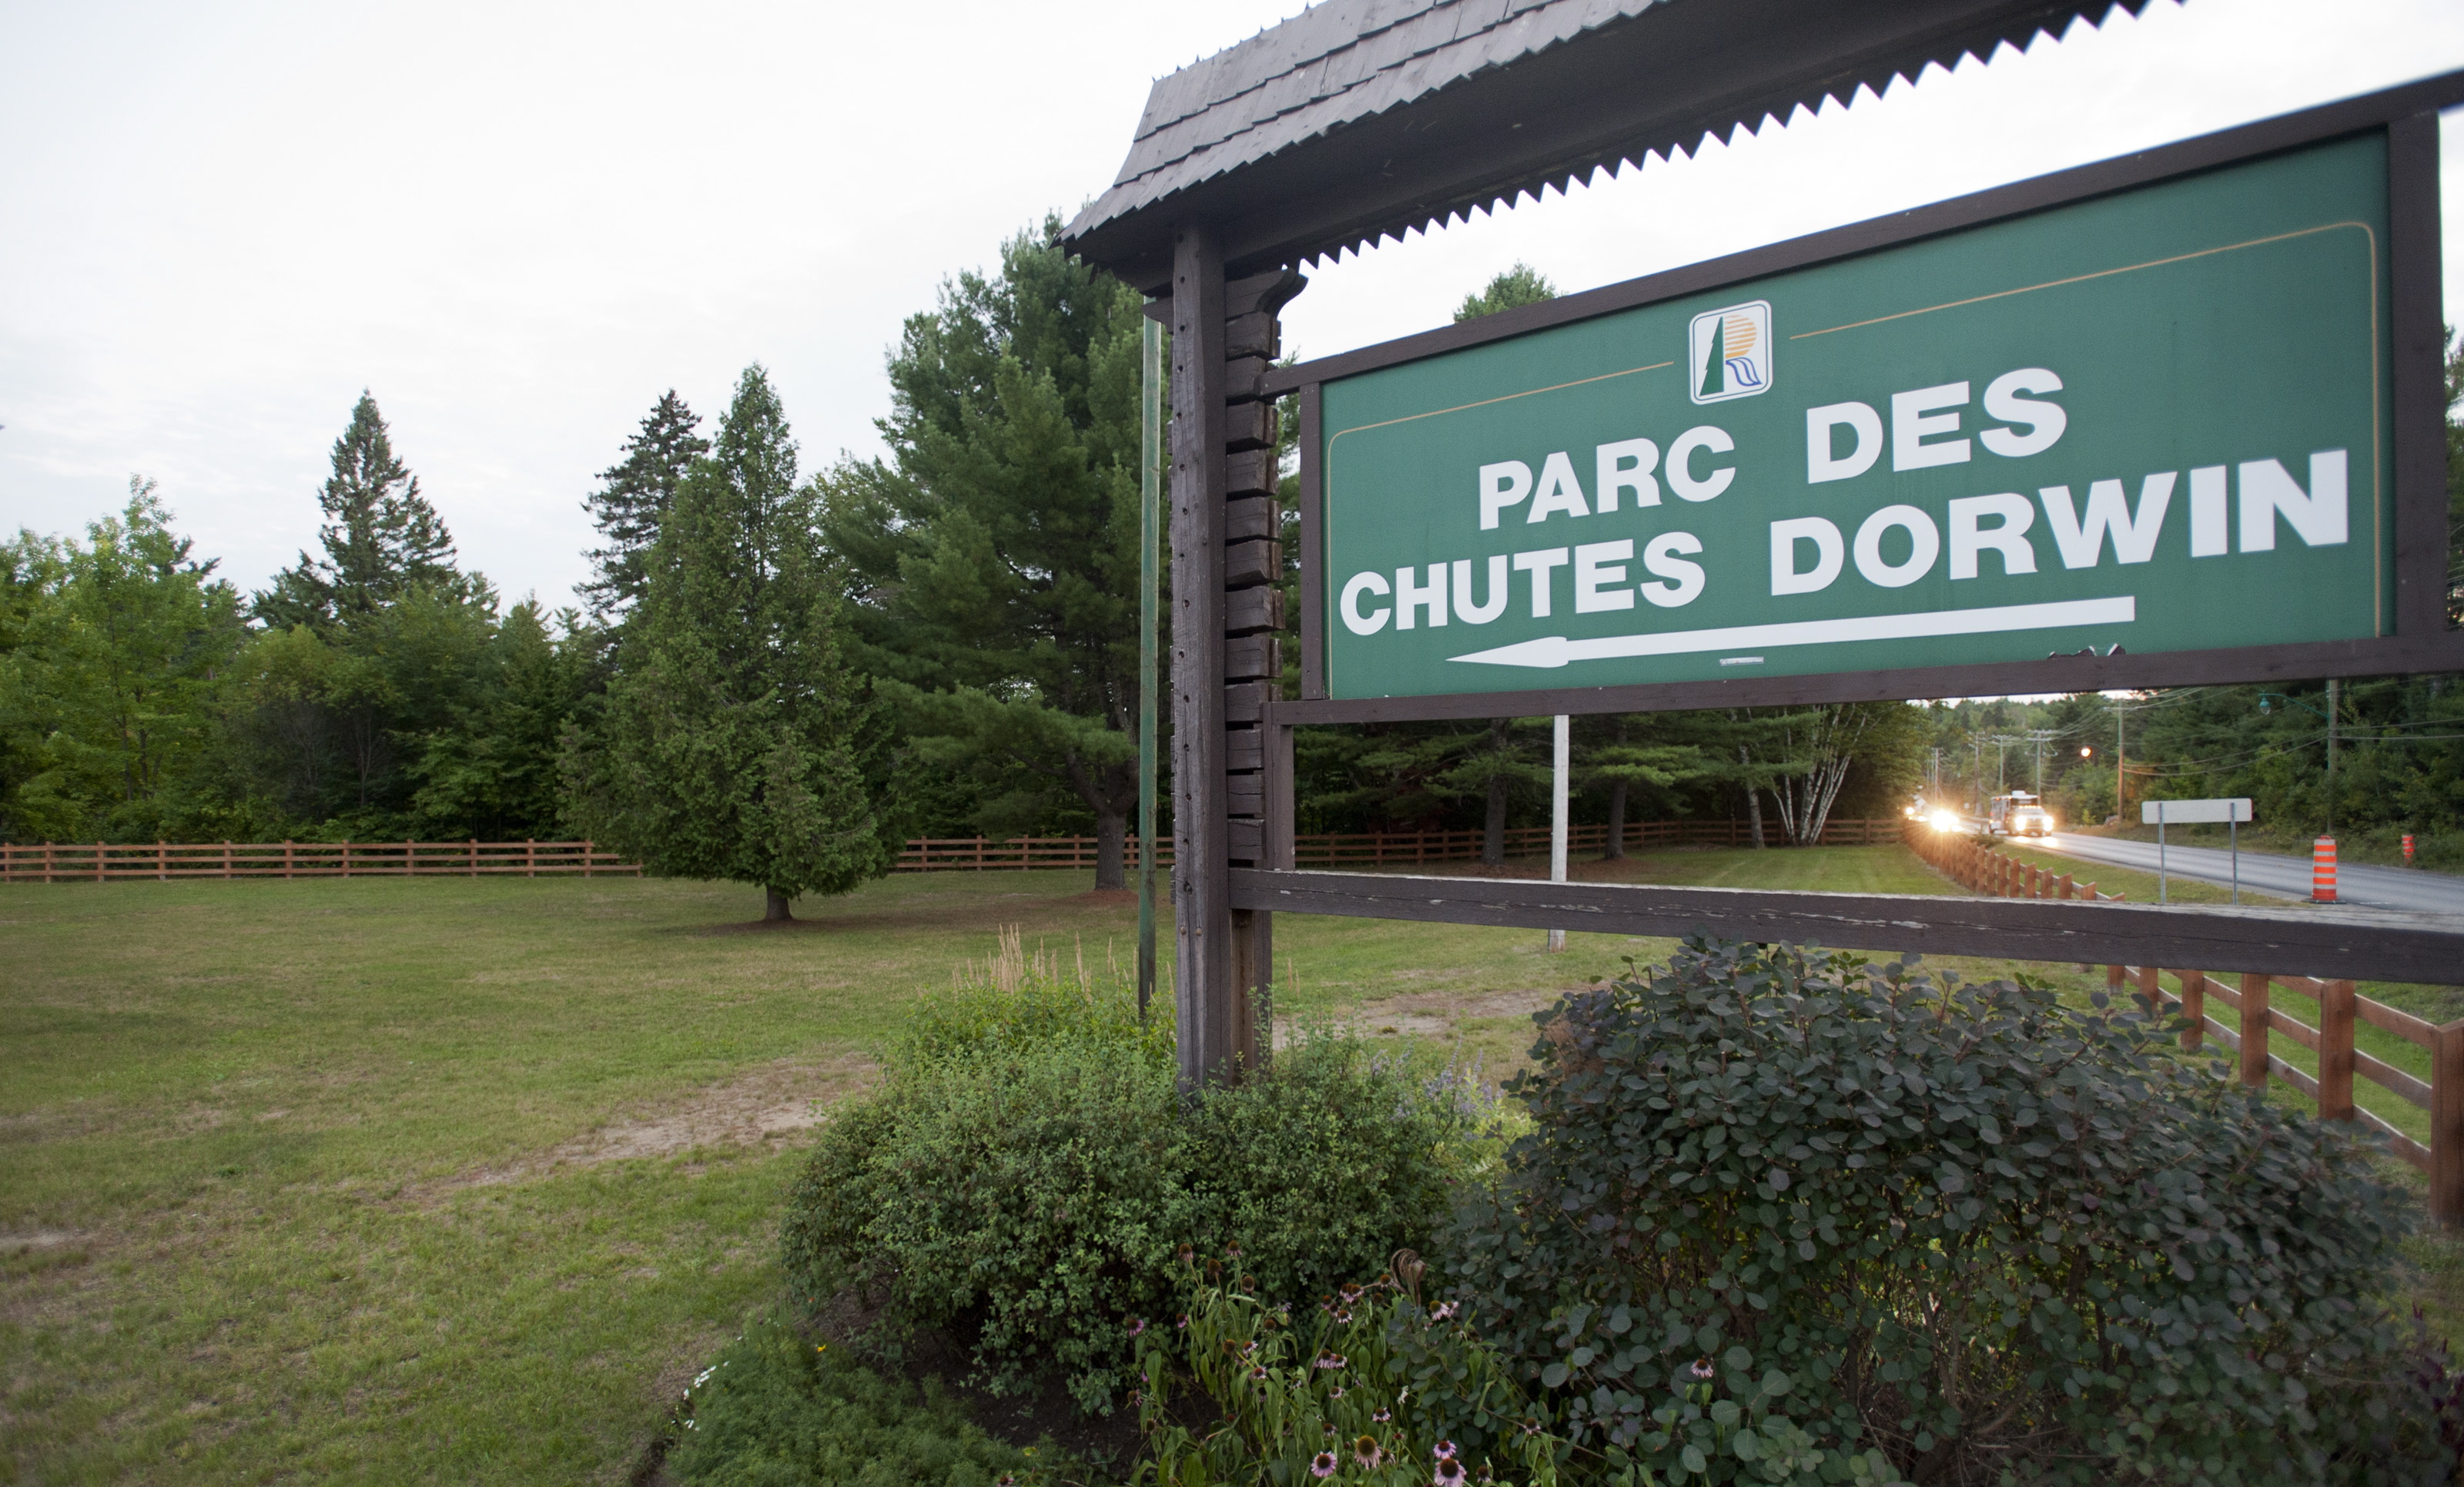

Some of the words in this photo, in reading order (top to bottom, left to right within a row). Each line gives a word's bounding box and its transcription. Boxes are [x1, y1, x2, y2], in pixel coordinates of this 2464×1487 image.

[1478, 425, 1736, 531] PARC
[1806, 368, 2067, 484] DES
[1339, 531, 1706, 637] CHUTES
[1769, 449, 2348, 597] DORWIN
